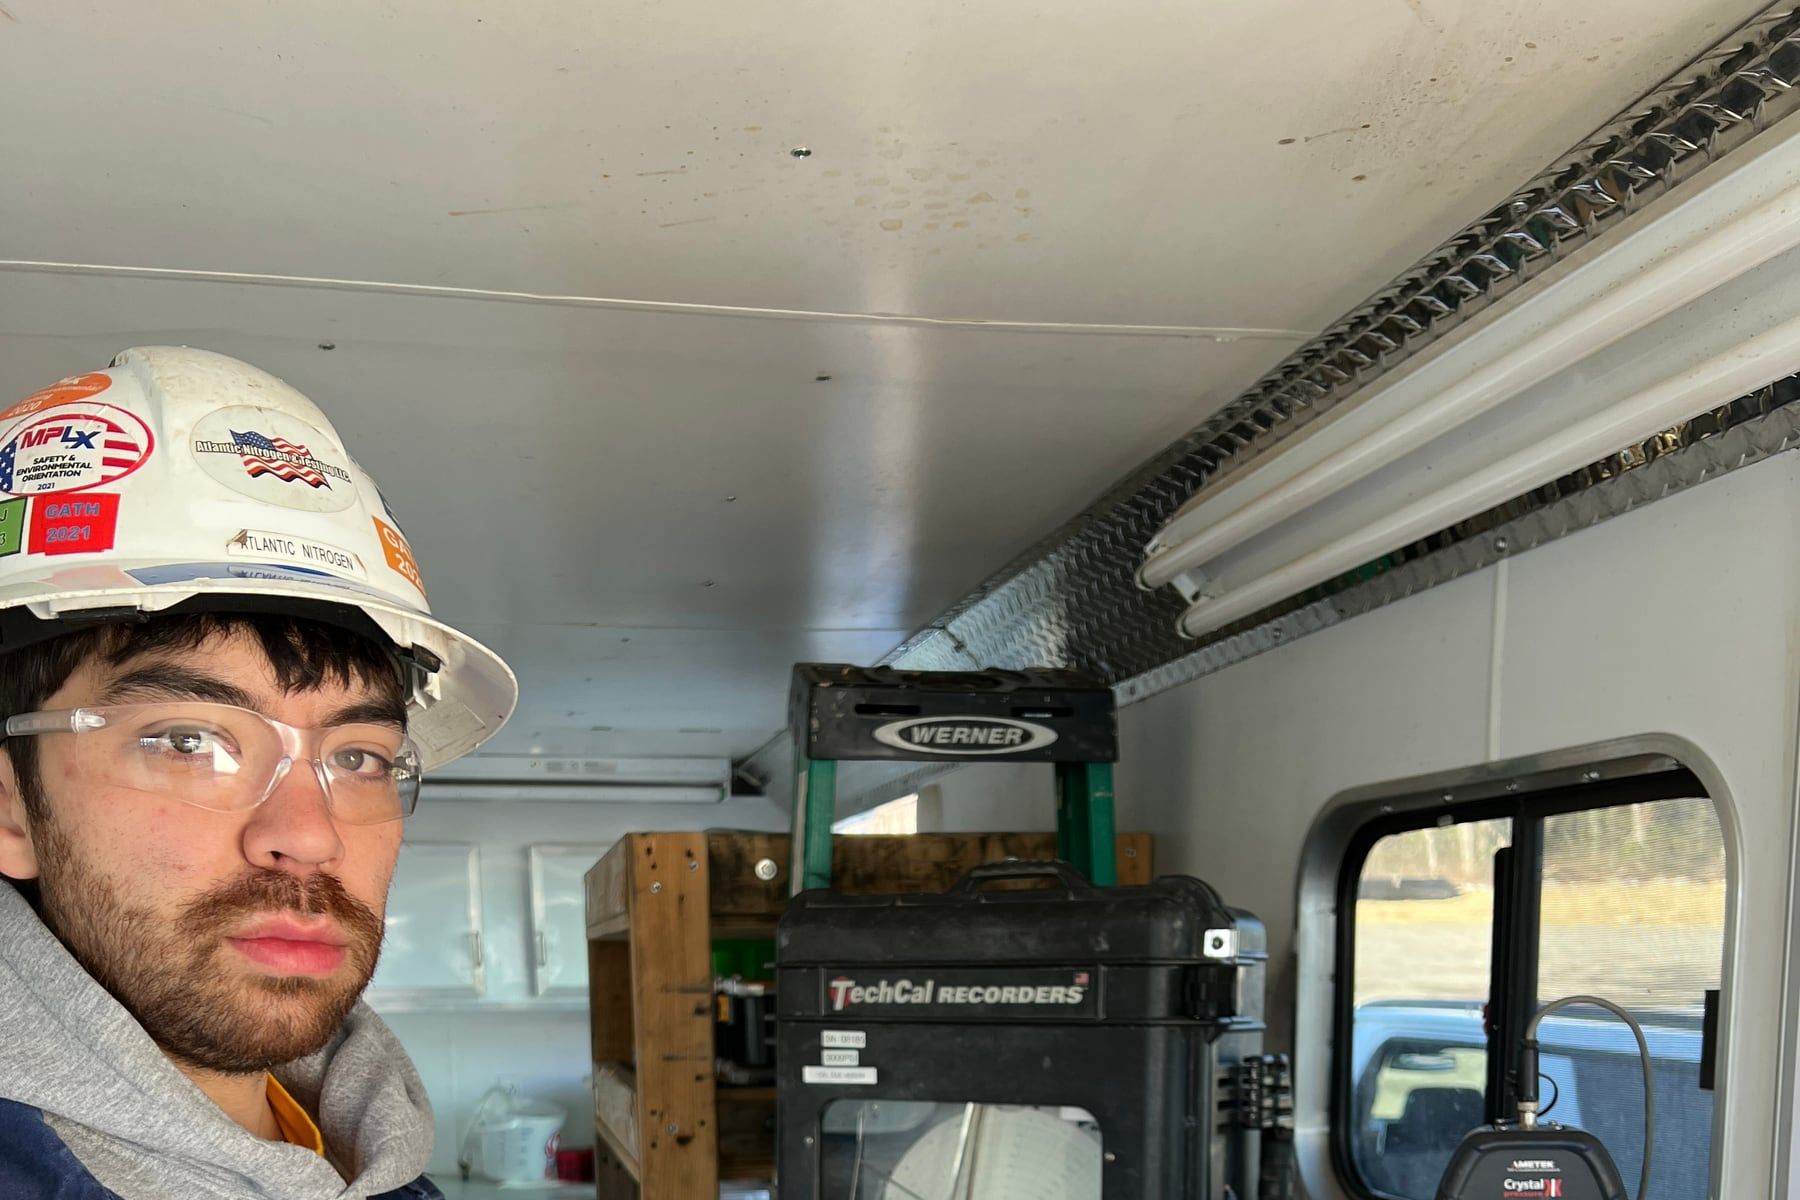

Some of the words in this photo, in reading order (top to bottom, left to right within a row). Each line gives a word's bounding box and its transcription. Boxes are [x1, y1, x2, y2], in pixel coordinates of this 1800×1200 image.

[20, 426, 101, 449] MPLX
[33, 455, 68, 465] SAFETY
[196, 440, 241, 454] Atlantic
[243, 444, 291, 462] Nitrogen
[291, 454, 300, 464] &
[299, 456, 337, 477] Testing
[16, 462, 93, 476] ENVIRONMENTAL
[22, 470, 81, 482] ORIENTATION
[37, 483, 55, 491] 2021
[45, 502, 100, 518] GATH
[47, 525, 91, 542] 2021
[302, 544, 354, 571] NITROGEN
[911, 726, 1023, 746] WERNER
[831, 979, 934, 1011] TechCal
[938, 986, 1084, 1004] RECORDERS
[1511, 1160, 1554, 1169] AMETEK
[1503, 1178, 1545, 1192] Crystal
